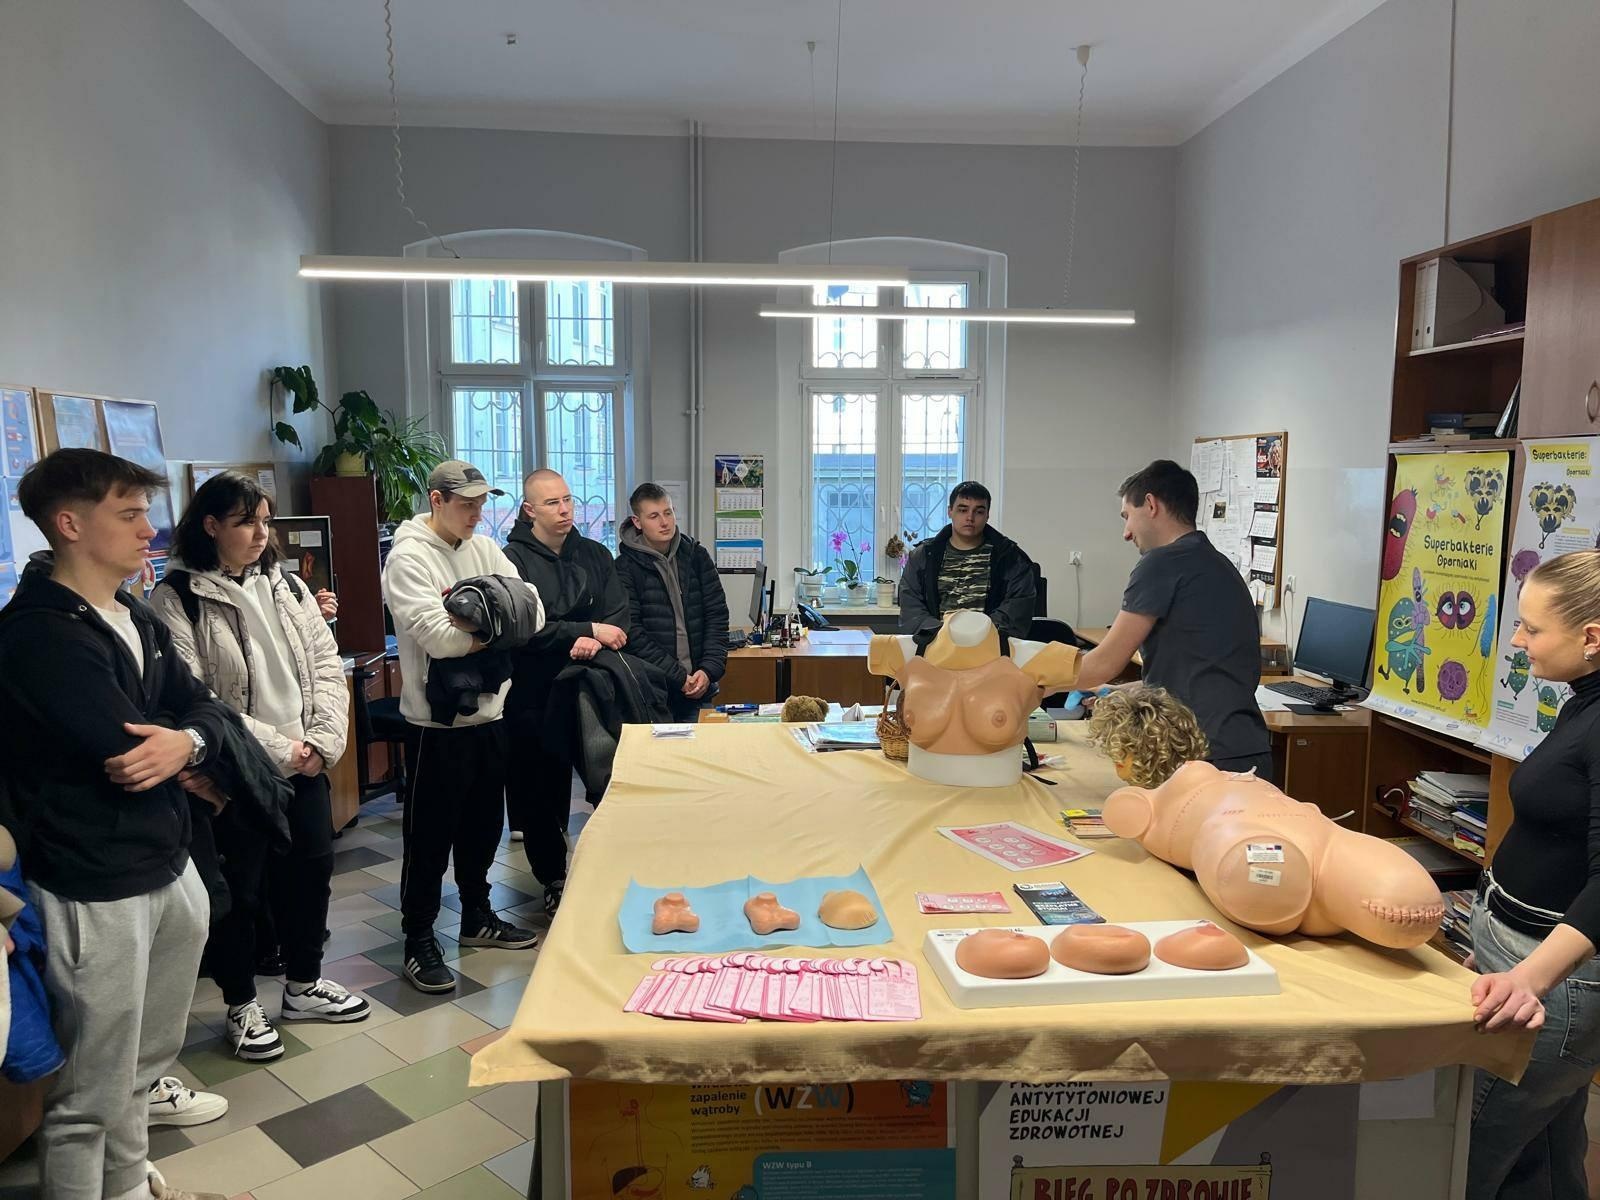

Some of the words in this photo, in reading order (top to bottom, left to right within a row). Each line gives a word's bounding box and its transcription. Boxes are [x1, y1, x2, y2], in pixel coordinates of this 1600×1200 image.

[1424, 534, 1494, 556] Superbakterie
[1437, 554, 1477, 571] Oporniaki
[690, 1090, 747, 1104] zapalenie
[1010, 1090, 1165, 1106] ANTYTYTONIOWEJ
[690, 1103, 741, 1116] wątroby
[1010, 1108, 1090, 1124] EDUKACJI
[1009, 1125, 1124, 1140] ZDROWOTNEJ
[762, 1161, 785, 1169] WZW
[1034, 1177, 1094, 1200] BIEG
[1105, 1177, 1138, 1200] PO
[1145, 1177, 1253, 1200] ZDROWIE
